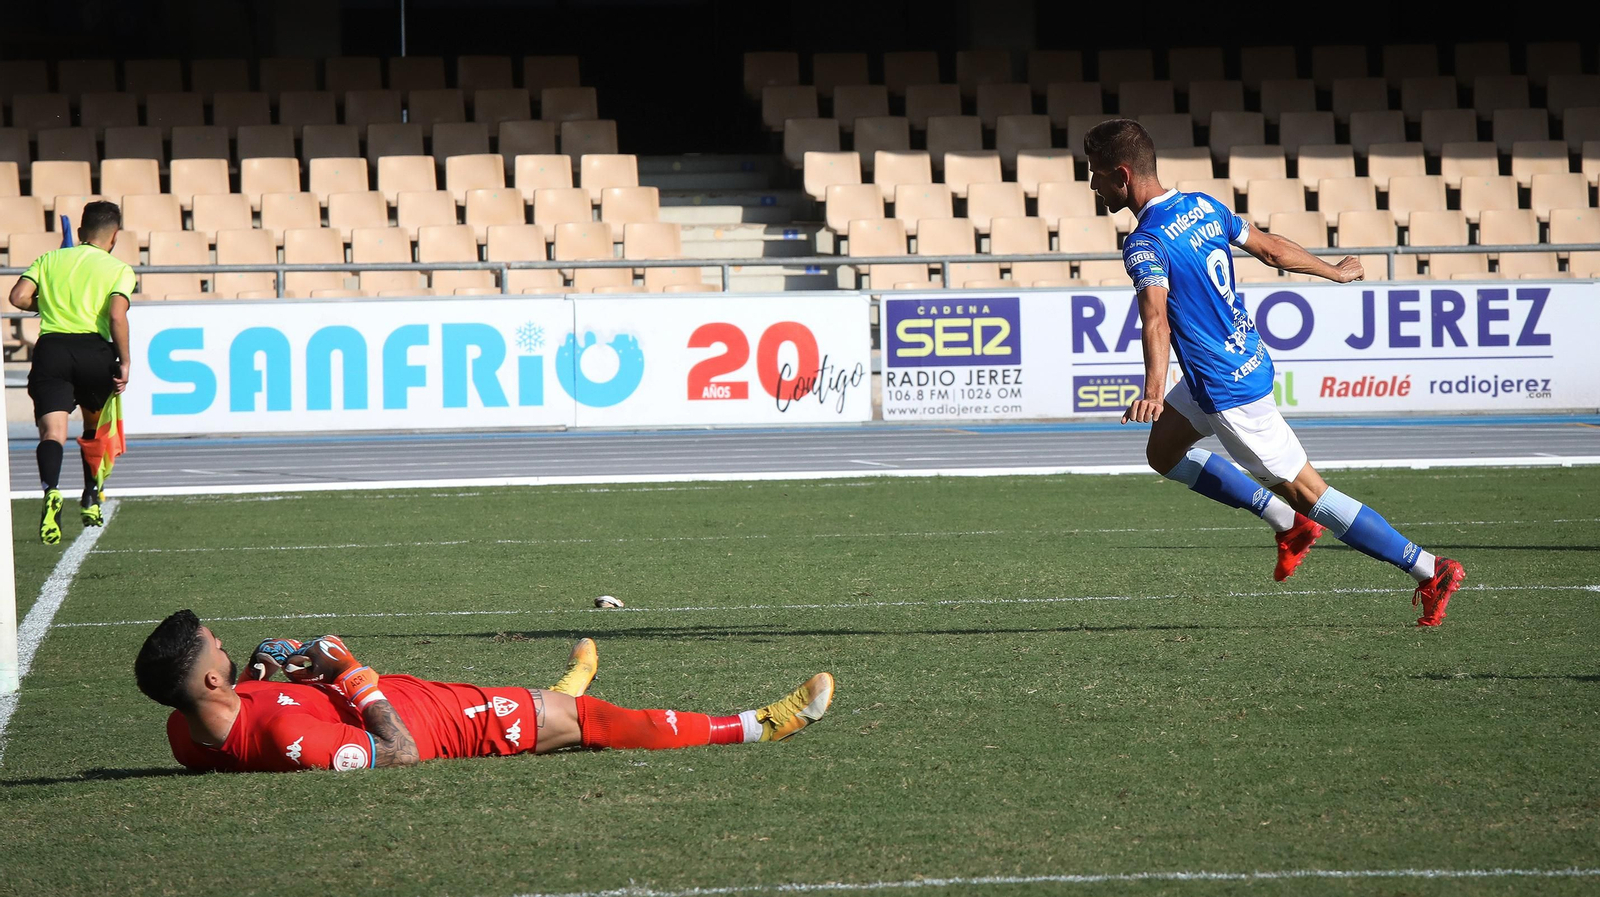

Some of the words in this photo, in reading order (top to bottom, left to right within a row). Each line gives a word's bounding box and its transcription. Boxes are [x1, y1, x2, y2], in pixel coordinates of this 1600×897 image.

[1190, 220, 1223, 252] MAYOR
[917, 305, 990, 315] CADENA
[1071, 289, 1315, 353] RAO
[1345, 286, 1552, 350] JEREZ
[896, 317, 1012, 357] SER
[687, 321, 819, 400] 20
[776, 354, 866, 414] Contigo
[887, 370, 955, 387] RADIO
[965, 369, 1023, 386] JEREZ
[1320, 375, 1411, 397] Radiolé
[1430, 375, 1551, 397] radiojerez
[702, 384, 731, 398] AÑOS
[888, 390, 924, 400] 106.8
[930, 389, 949, 400] FM
[960, 388, 992, 399] 1026
[998, 388, 1022, 399] OM
[1077, 385, 1141, 408] SER
[887, 404, 1022, 416] www.radiojerez.com
[463, 701, 493, 719] 1
